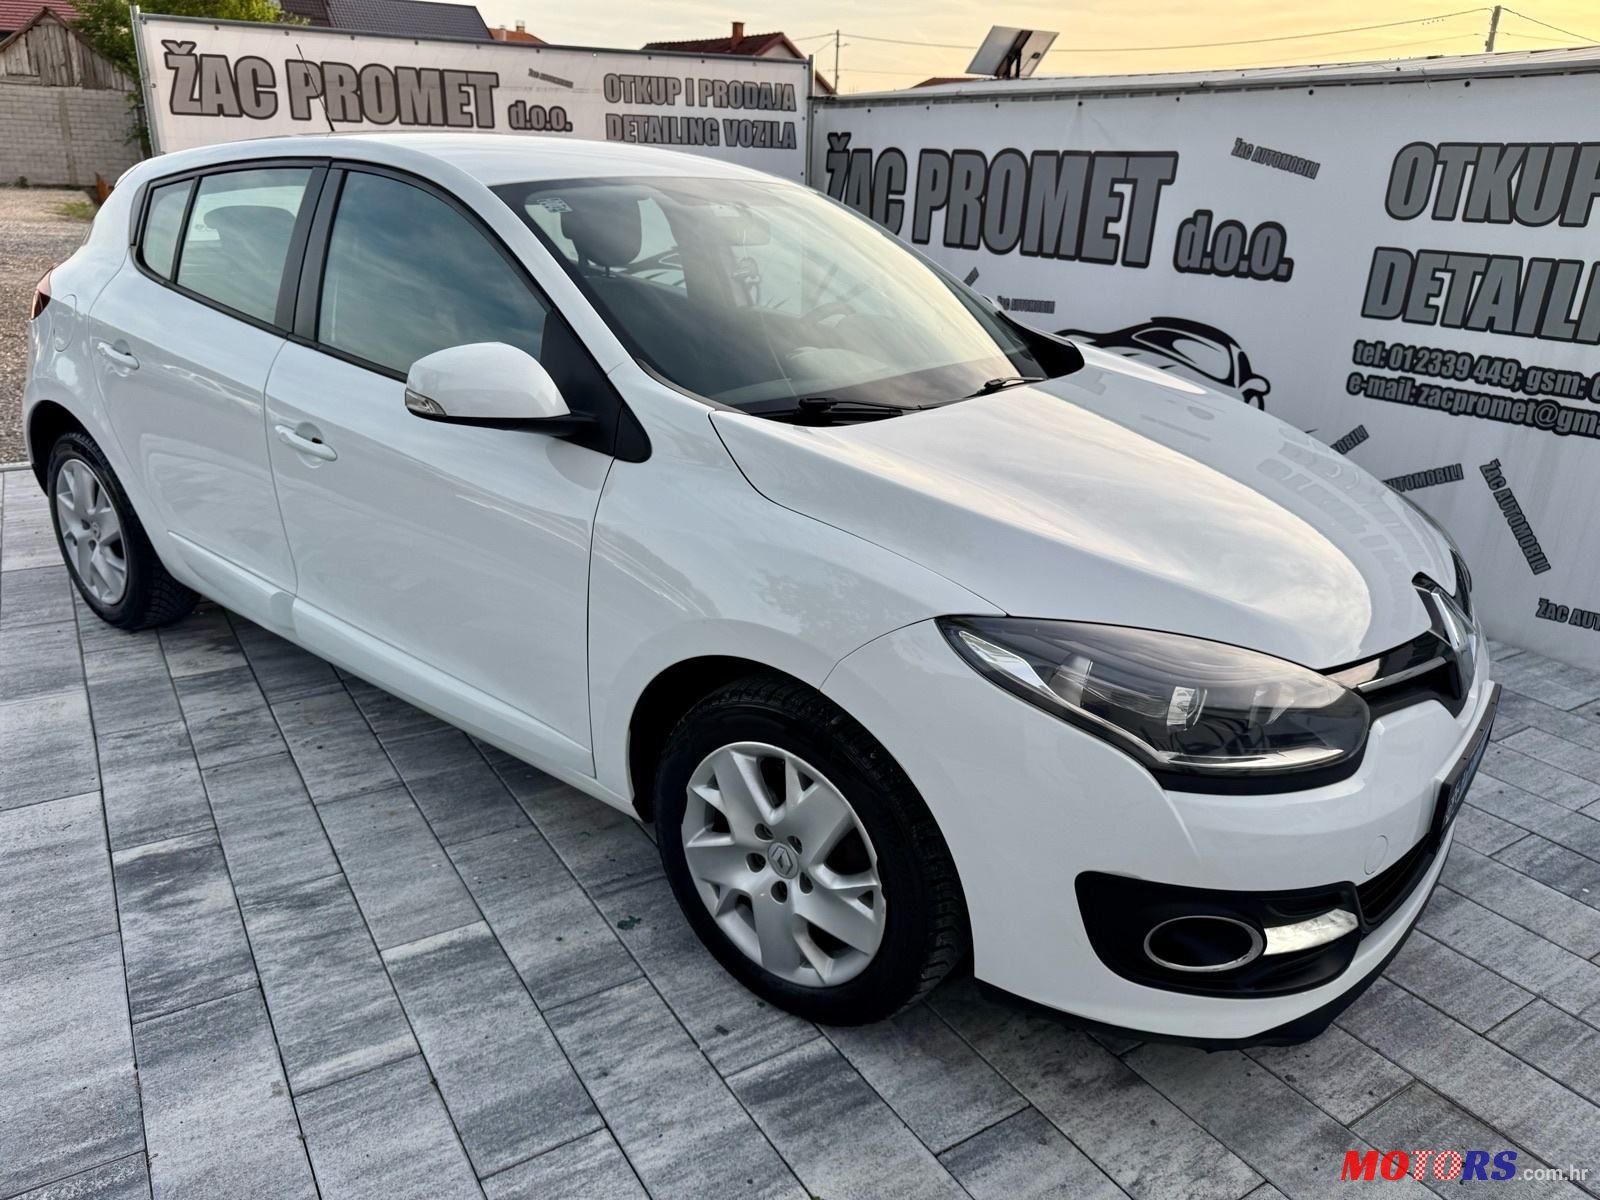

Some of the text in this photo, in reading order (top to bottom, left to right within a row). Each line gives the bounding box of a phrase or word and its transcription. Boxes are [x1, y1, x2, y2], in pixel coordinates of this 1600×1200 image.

[161, 40, 573, 132] ŽAC PROMET d.o.o.
[603, 73, 682, 106] OTKUP
[685, 78, 695, 106] I
[697, 78, 797, 111] PRODAJA
[605, 113, 797, 149] DETAILING VOZILA
[1250, 145, 1321, 180] AUTOMOBILI
[911, 147, 1179, 269] PROMET
[1173, 209, 1294, 282] d.o.o.
[1352, 339, 1388, 369] tel:
[1521, 366, 1588, 400] gsm:
[1346, 372, 1418, 406] e-mail:
[1479, 458, 1552, 576] ŽAC AUTOMOBILI
[1535, 597, 1570, 623] ŽAC
